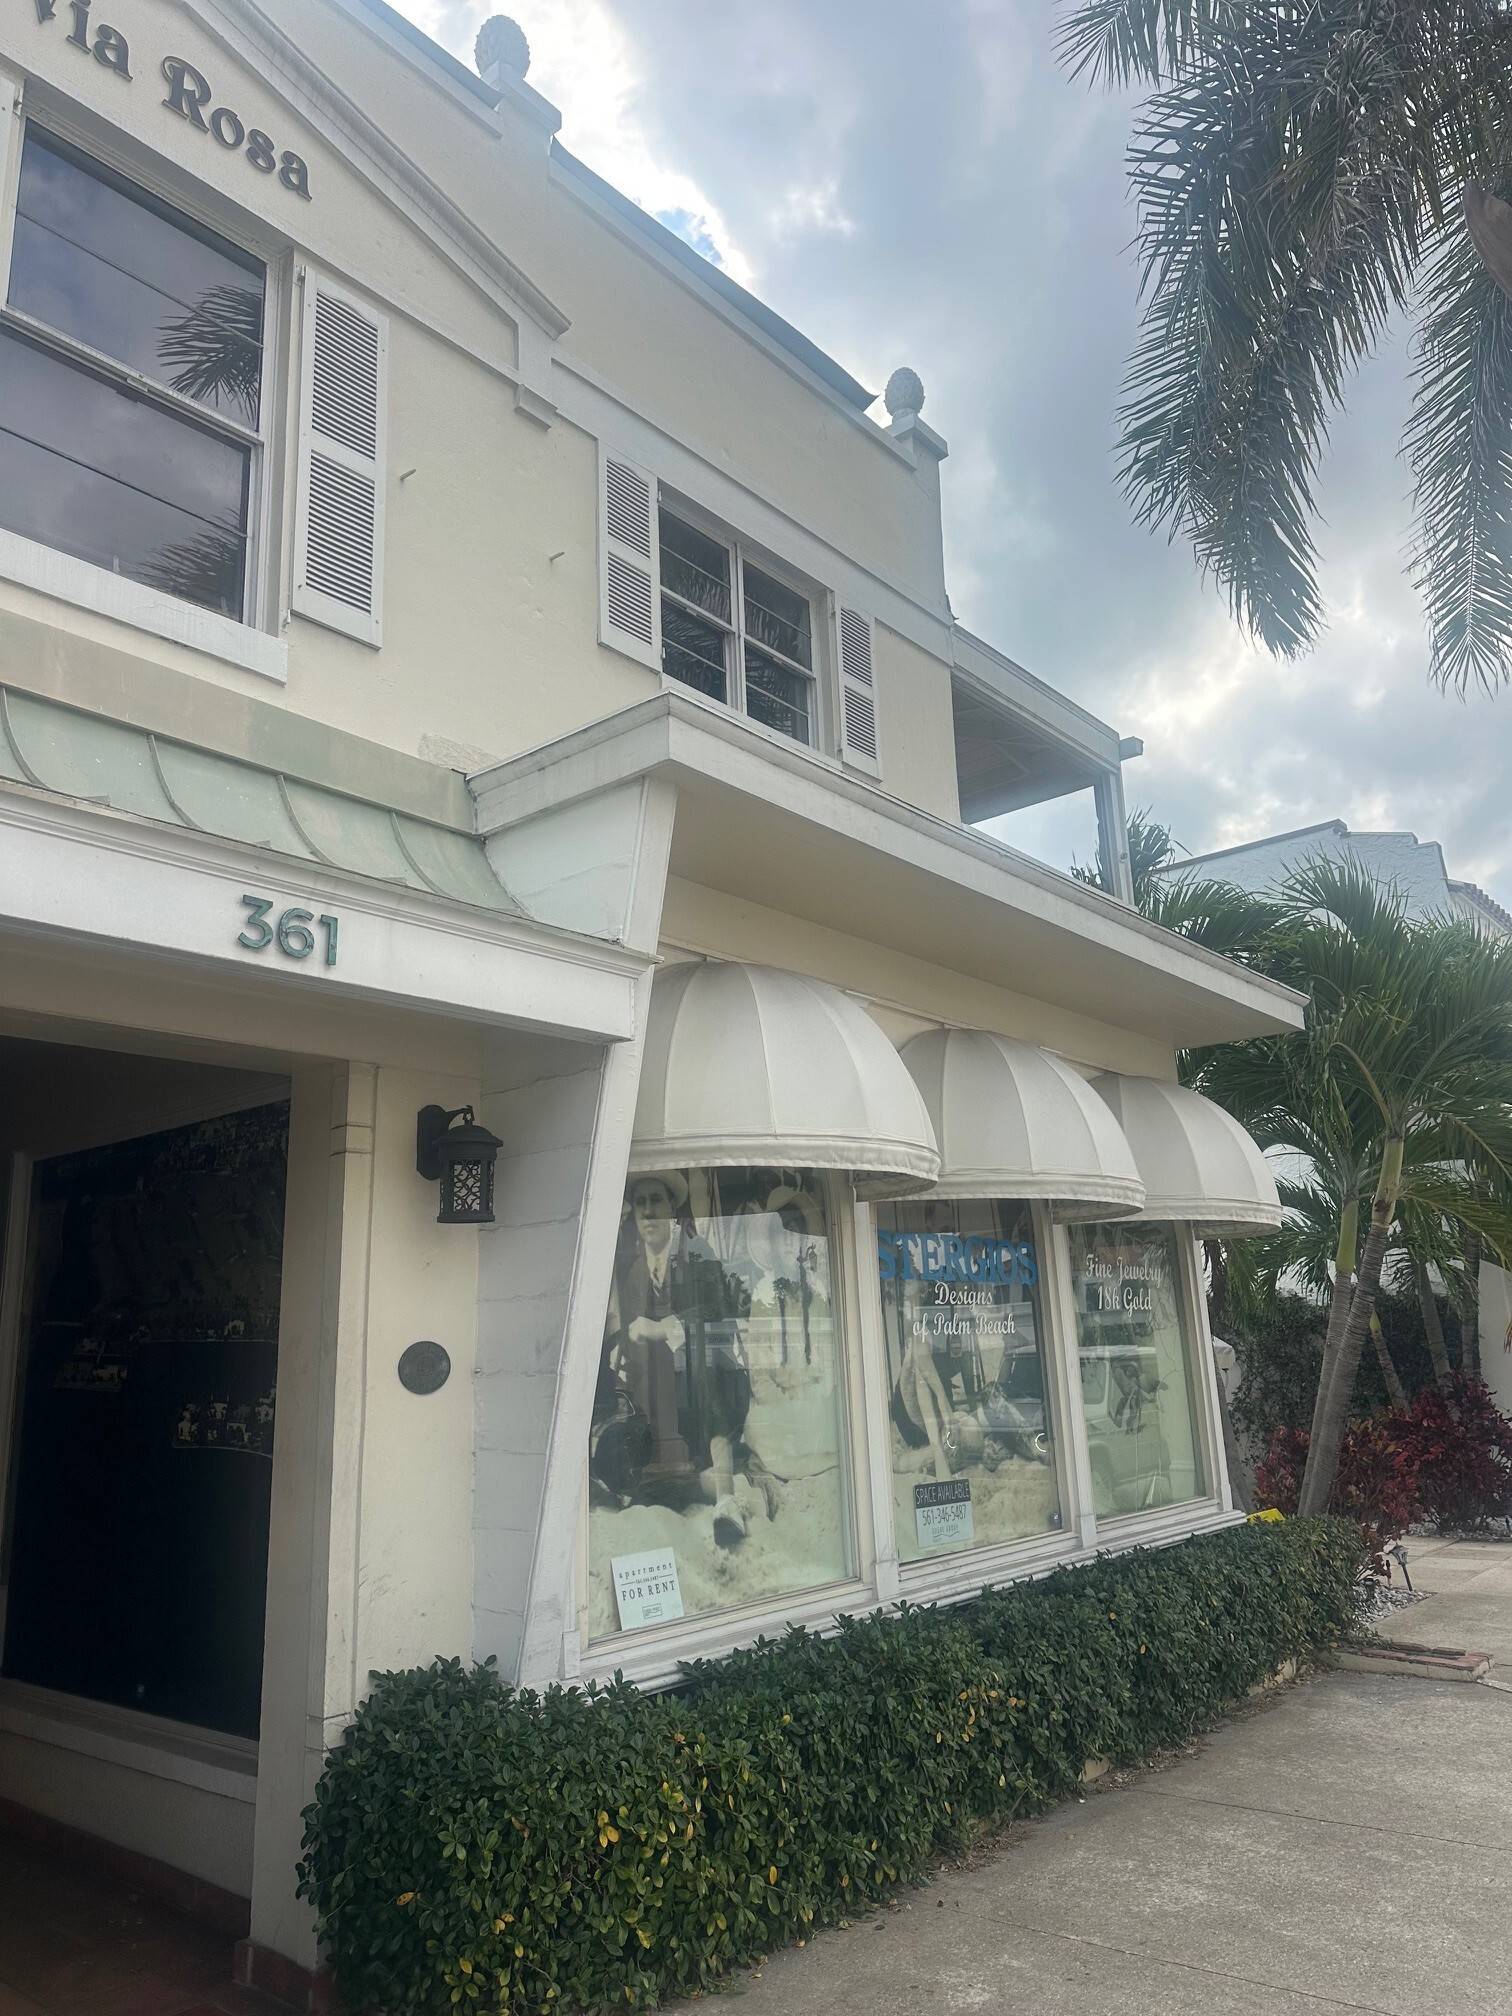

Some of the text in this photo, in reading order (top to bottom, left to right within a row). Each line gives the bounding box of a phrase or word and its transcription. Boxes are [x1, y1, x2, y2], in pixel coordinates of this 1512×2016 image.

[161, 55, 313, 202] Rosa
[237, 894, 338, 966] 361
[878, 1230, 1038, 1285] STERGIOS
[1086, 1253, 1164, 1289] Fine Jewelry
[934, 1281, 993, 1311] Designs
[1097, 1285, 1152, 1318] 18k Gold
[912, 1312, 1016, 1343] of Palm Beach
[916, 1483, 969, 1504] SPACE AVAILABLE
[619, 1562, 672, 1579] apartment
[622, 1580, 674, 1601] FOR RENT
